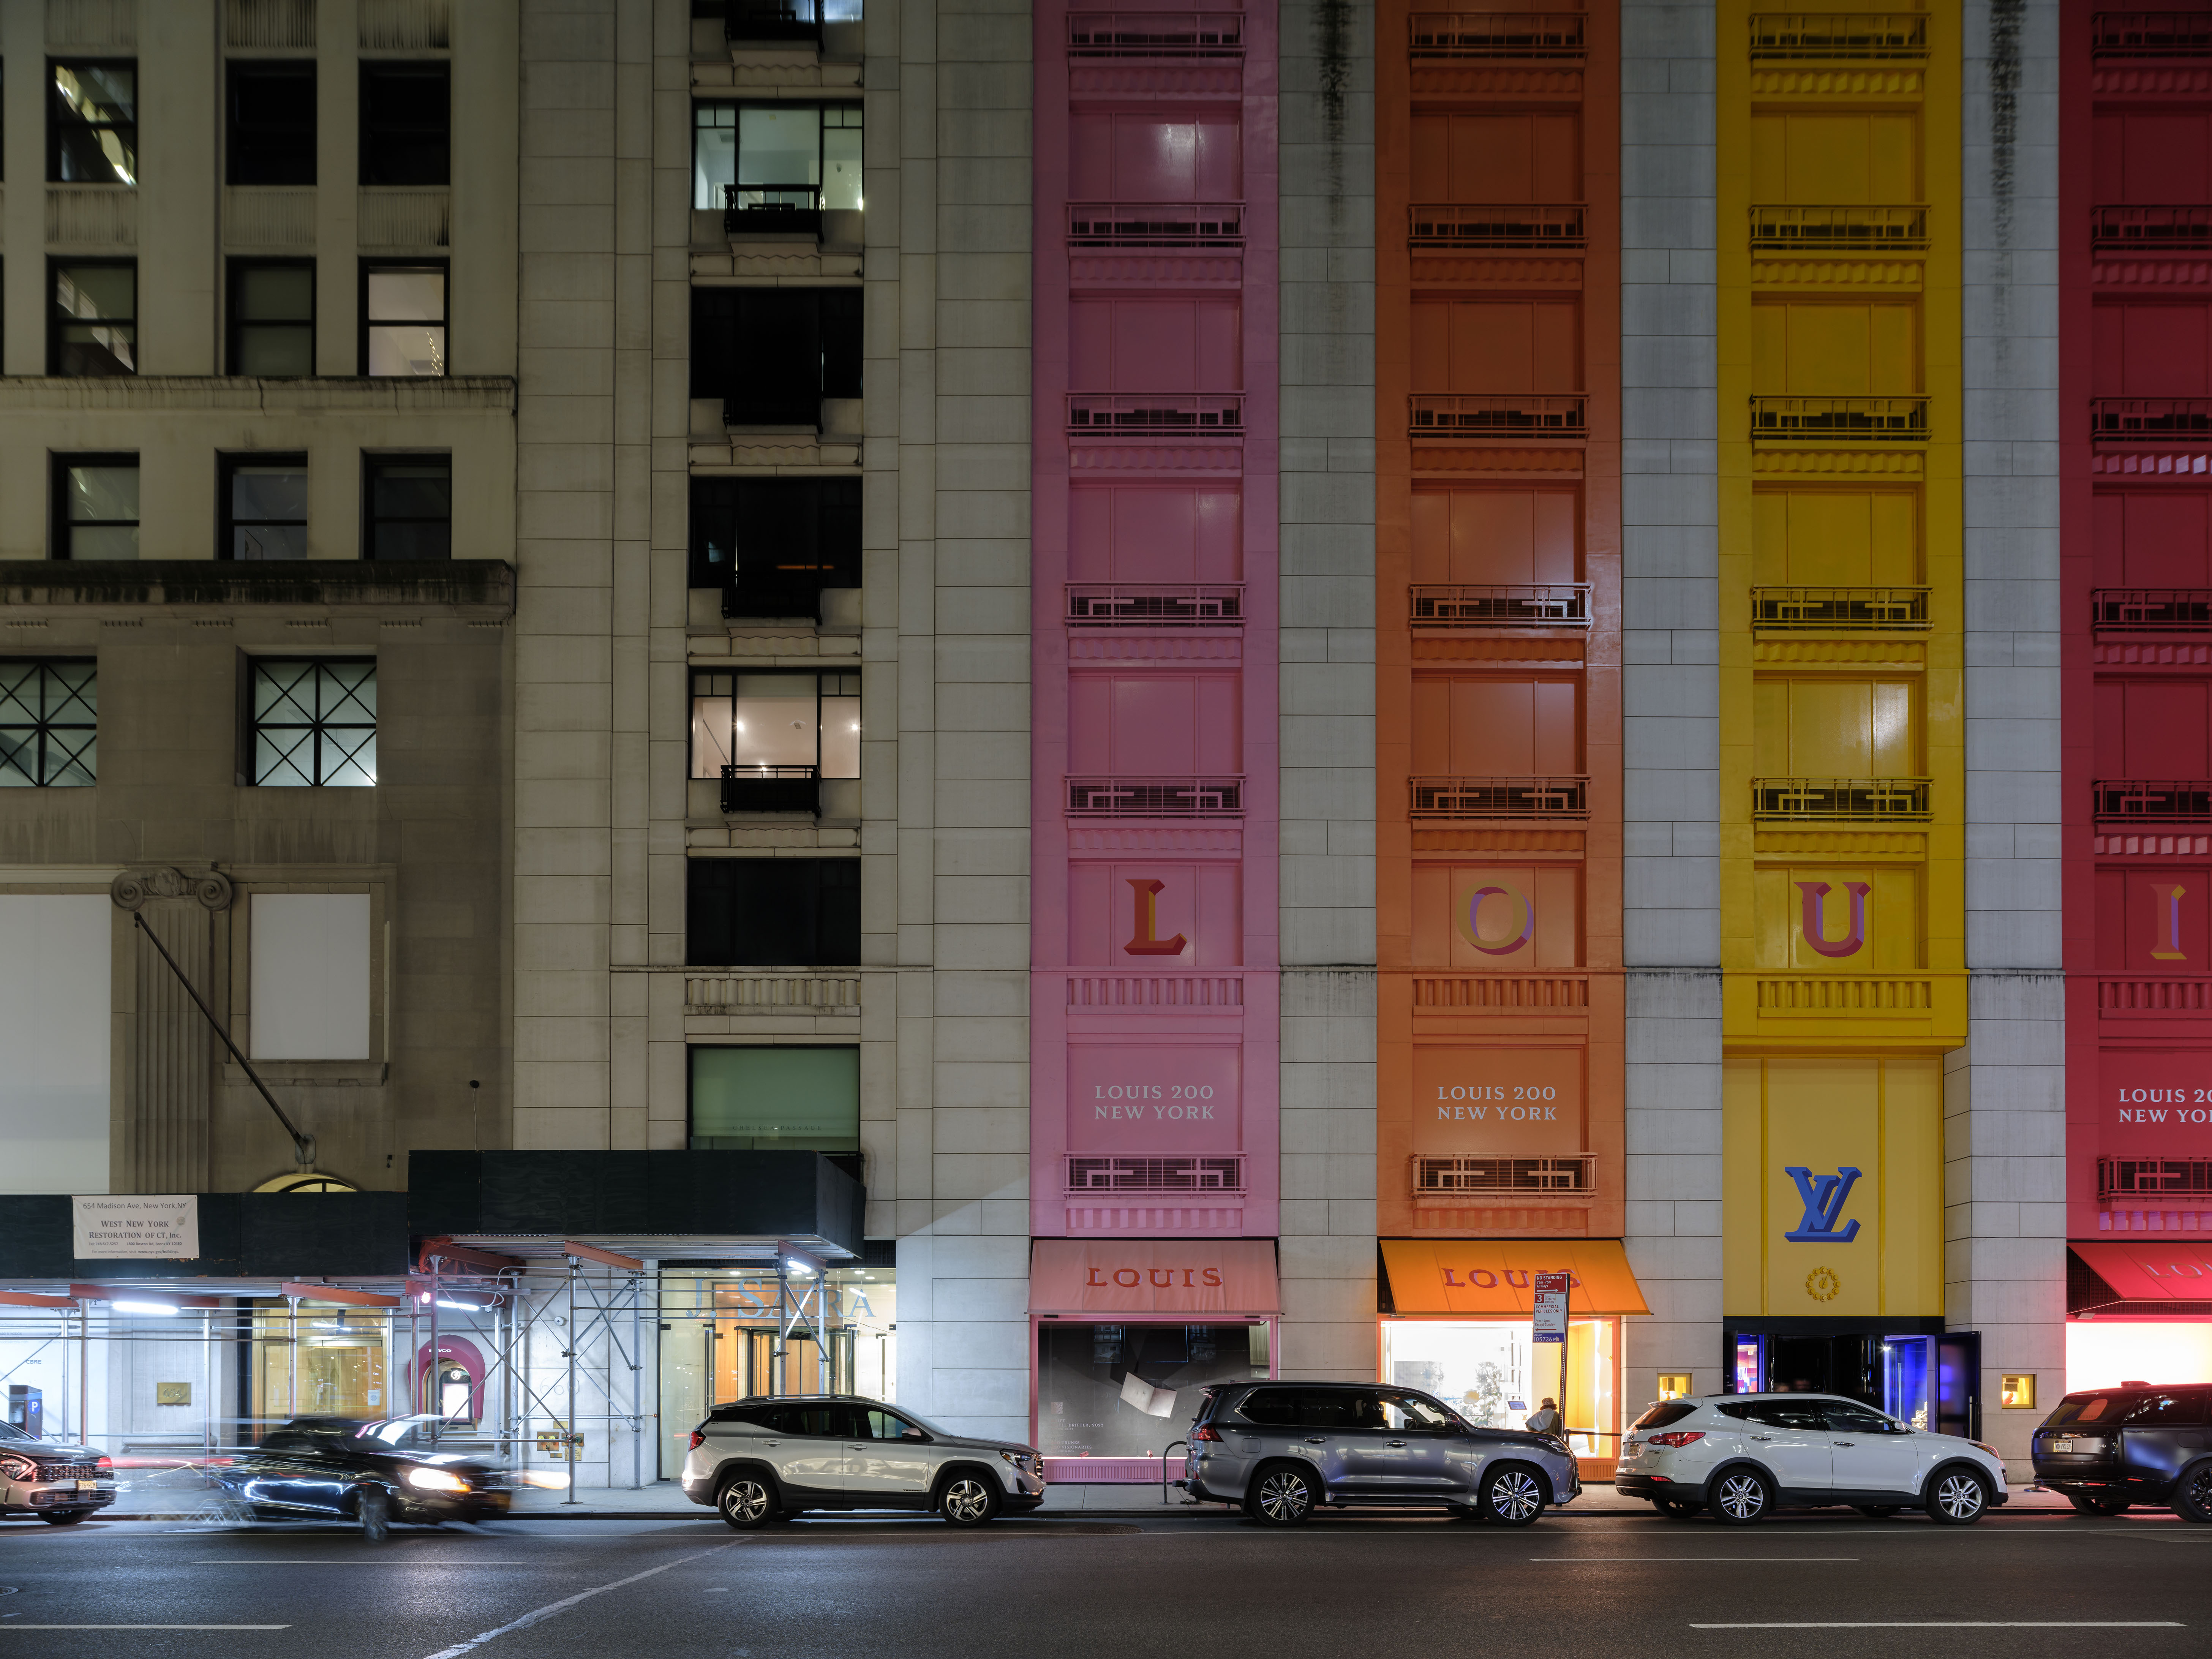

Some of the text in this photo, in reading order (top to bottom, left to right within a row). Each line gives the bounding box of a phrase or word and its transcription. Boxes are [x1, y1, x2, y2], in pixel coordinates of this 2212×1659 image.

[1123, 879, 2187, 959] L O U I
[1095, 1085, 1213, 1099] LOUIS 200
[1438, 1086, 1556, 1100] LOUIS 200
[2119, 1089, 2185, 1103] LOUIS
[1095, 1106, 1215, 1119] NEW YORK
[1438, 1107, 1557, 1120] NEW YORK
[2119, 1109, 2212, 1123] NEW YO
[1086, 1267, 1223, 1288] LOUIS
[1441, 1268, 1581, 1289] LOUS
[685, 1278, 877, 1318] J. SAFRA
[163, 1388, 182, 1398] 654
[32, 1401, 38, 1412] P
